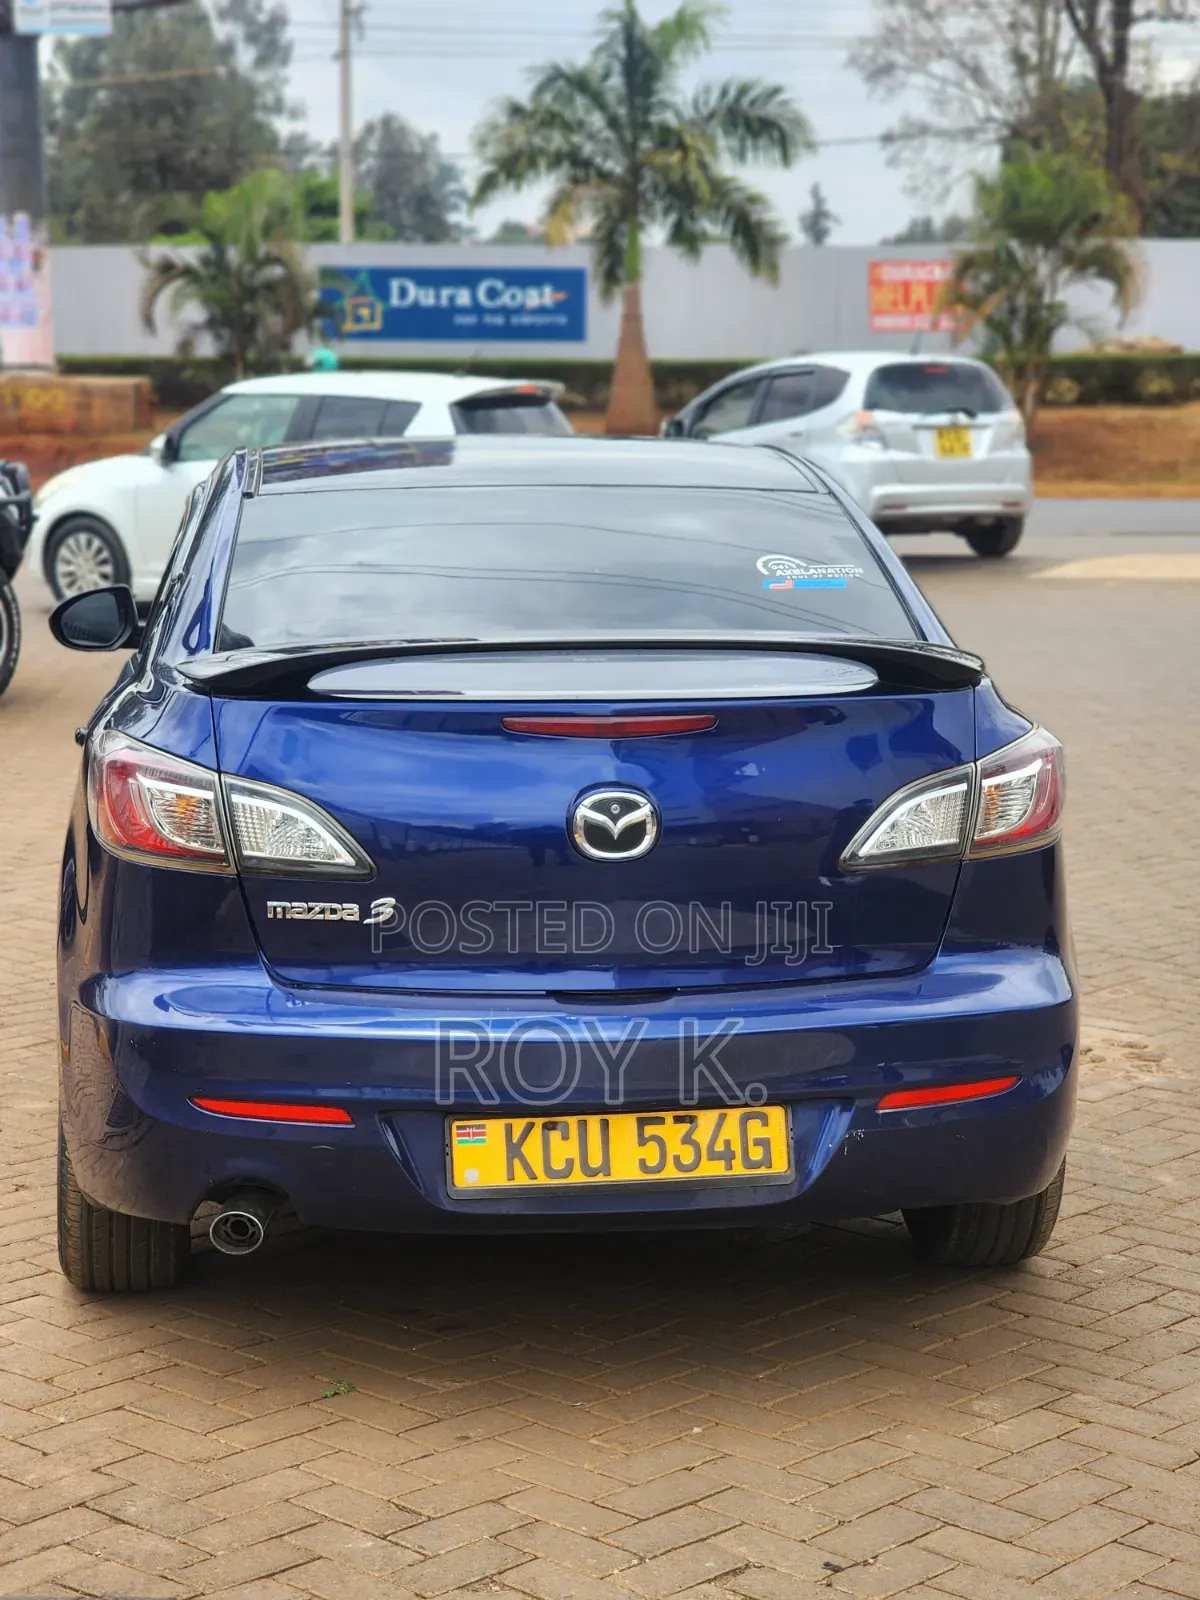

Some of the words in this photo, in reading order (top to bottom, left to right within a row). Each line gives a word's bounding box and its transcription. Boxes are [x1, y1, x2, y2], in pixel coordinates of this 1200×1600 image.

[388, 276, 473, 309] Dura
[775, 567, 864, 577] AXELANATION
[363, 897, 396, 924] 3
[503, 1118, 611, 1181] KCU
[636, 1111, 772, 1175] 534G
